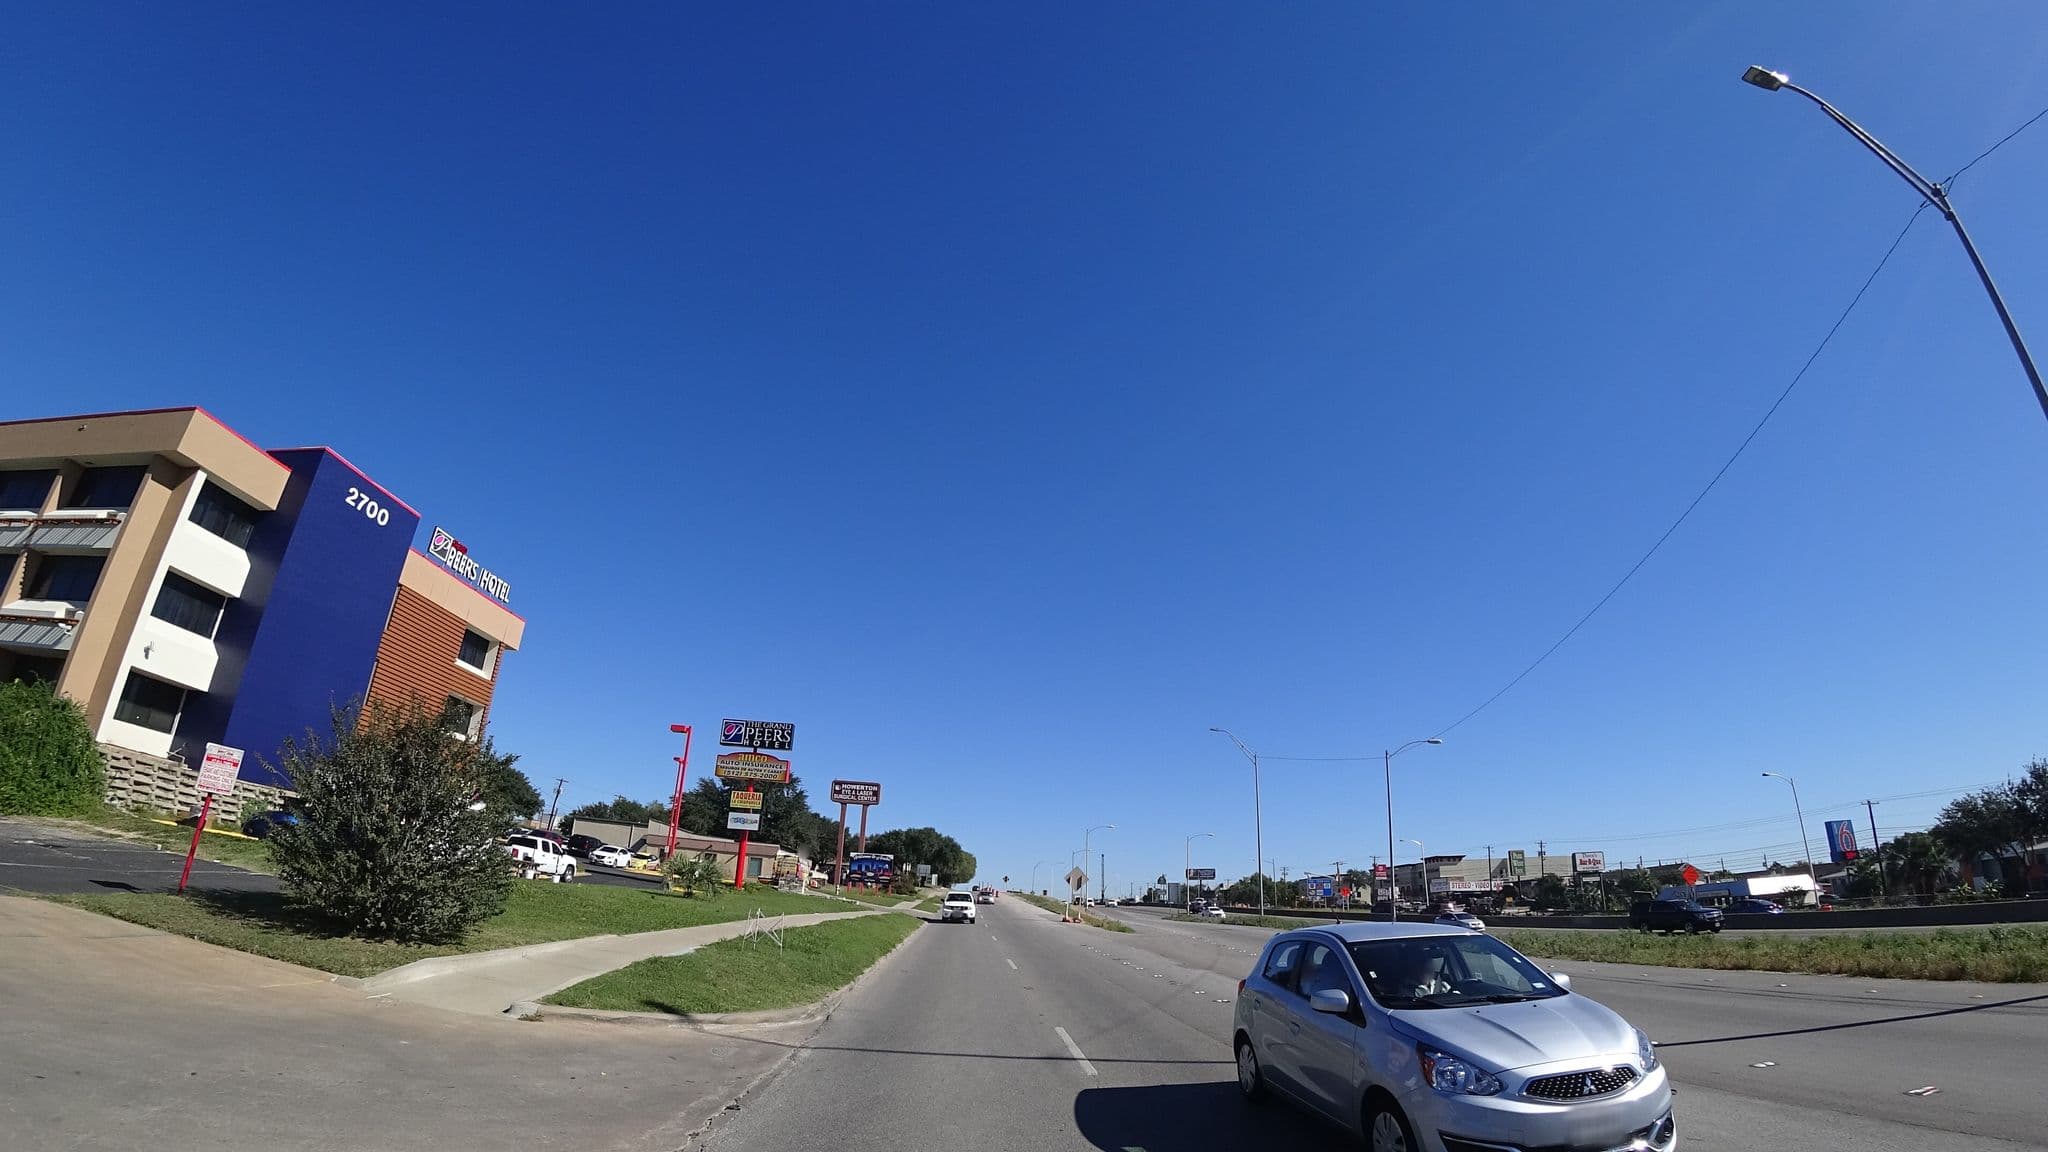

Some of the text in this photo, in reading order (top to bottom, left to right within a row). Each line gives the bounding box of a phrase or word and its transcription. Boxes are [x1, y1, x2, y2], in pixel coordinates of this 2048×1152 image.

[345, 487, 390, 526] 2700
[447, 546, 512, 604] PEERS HOTEL
[763, 722, 792, 730] GRAND
[745, 727, 791, 743] PEERS
[743, 740, 789, 749] HOTEL
[738, 753, 768, 762] amco
[741, 761, 784, 770] INSURANCE
[732, 791, 762, 800] TAQUERIA
[1839, 820, 1856, 852] 6
[1451, 881, 1472, 889] STEREO
